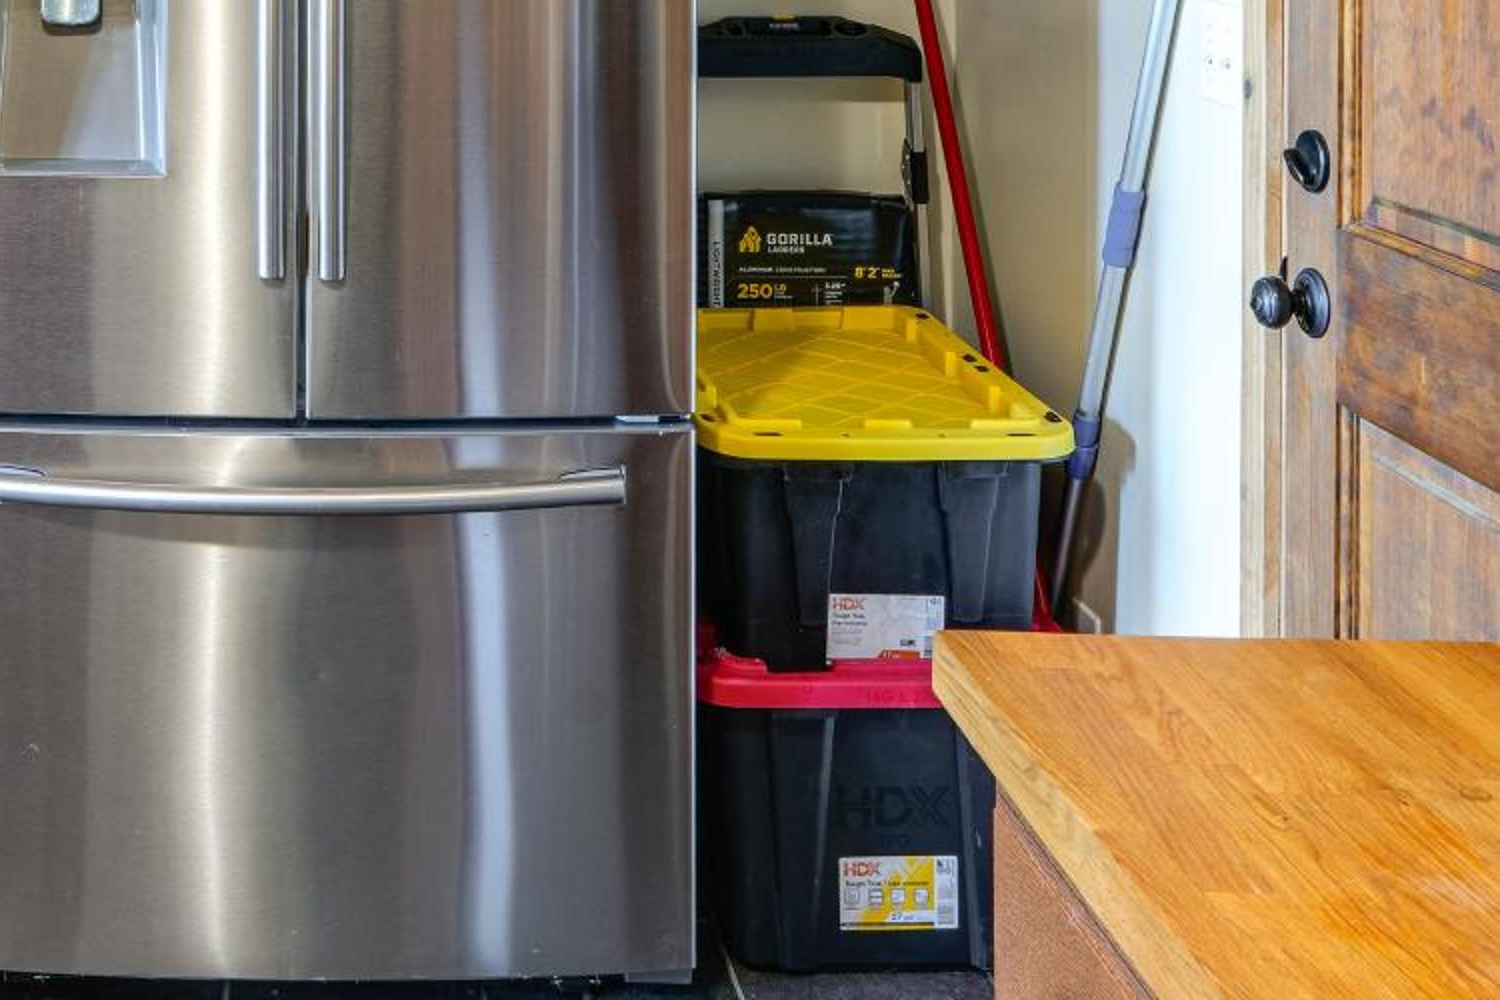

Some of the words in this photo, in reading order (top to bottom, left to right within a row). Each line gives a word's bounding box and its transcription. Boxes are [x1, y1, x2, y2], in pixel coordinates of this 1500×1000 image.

[766, 232, 833, 246] GORILLA
[737, 283, 773, 299] 250
[832, 597, 867, 611] HDX
[836, 786, 949, 825] HDX
[843, 861, 880, 877] HDX
